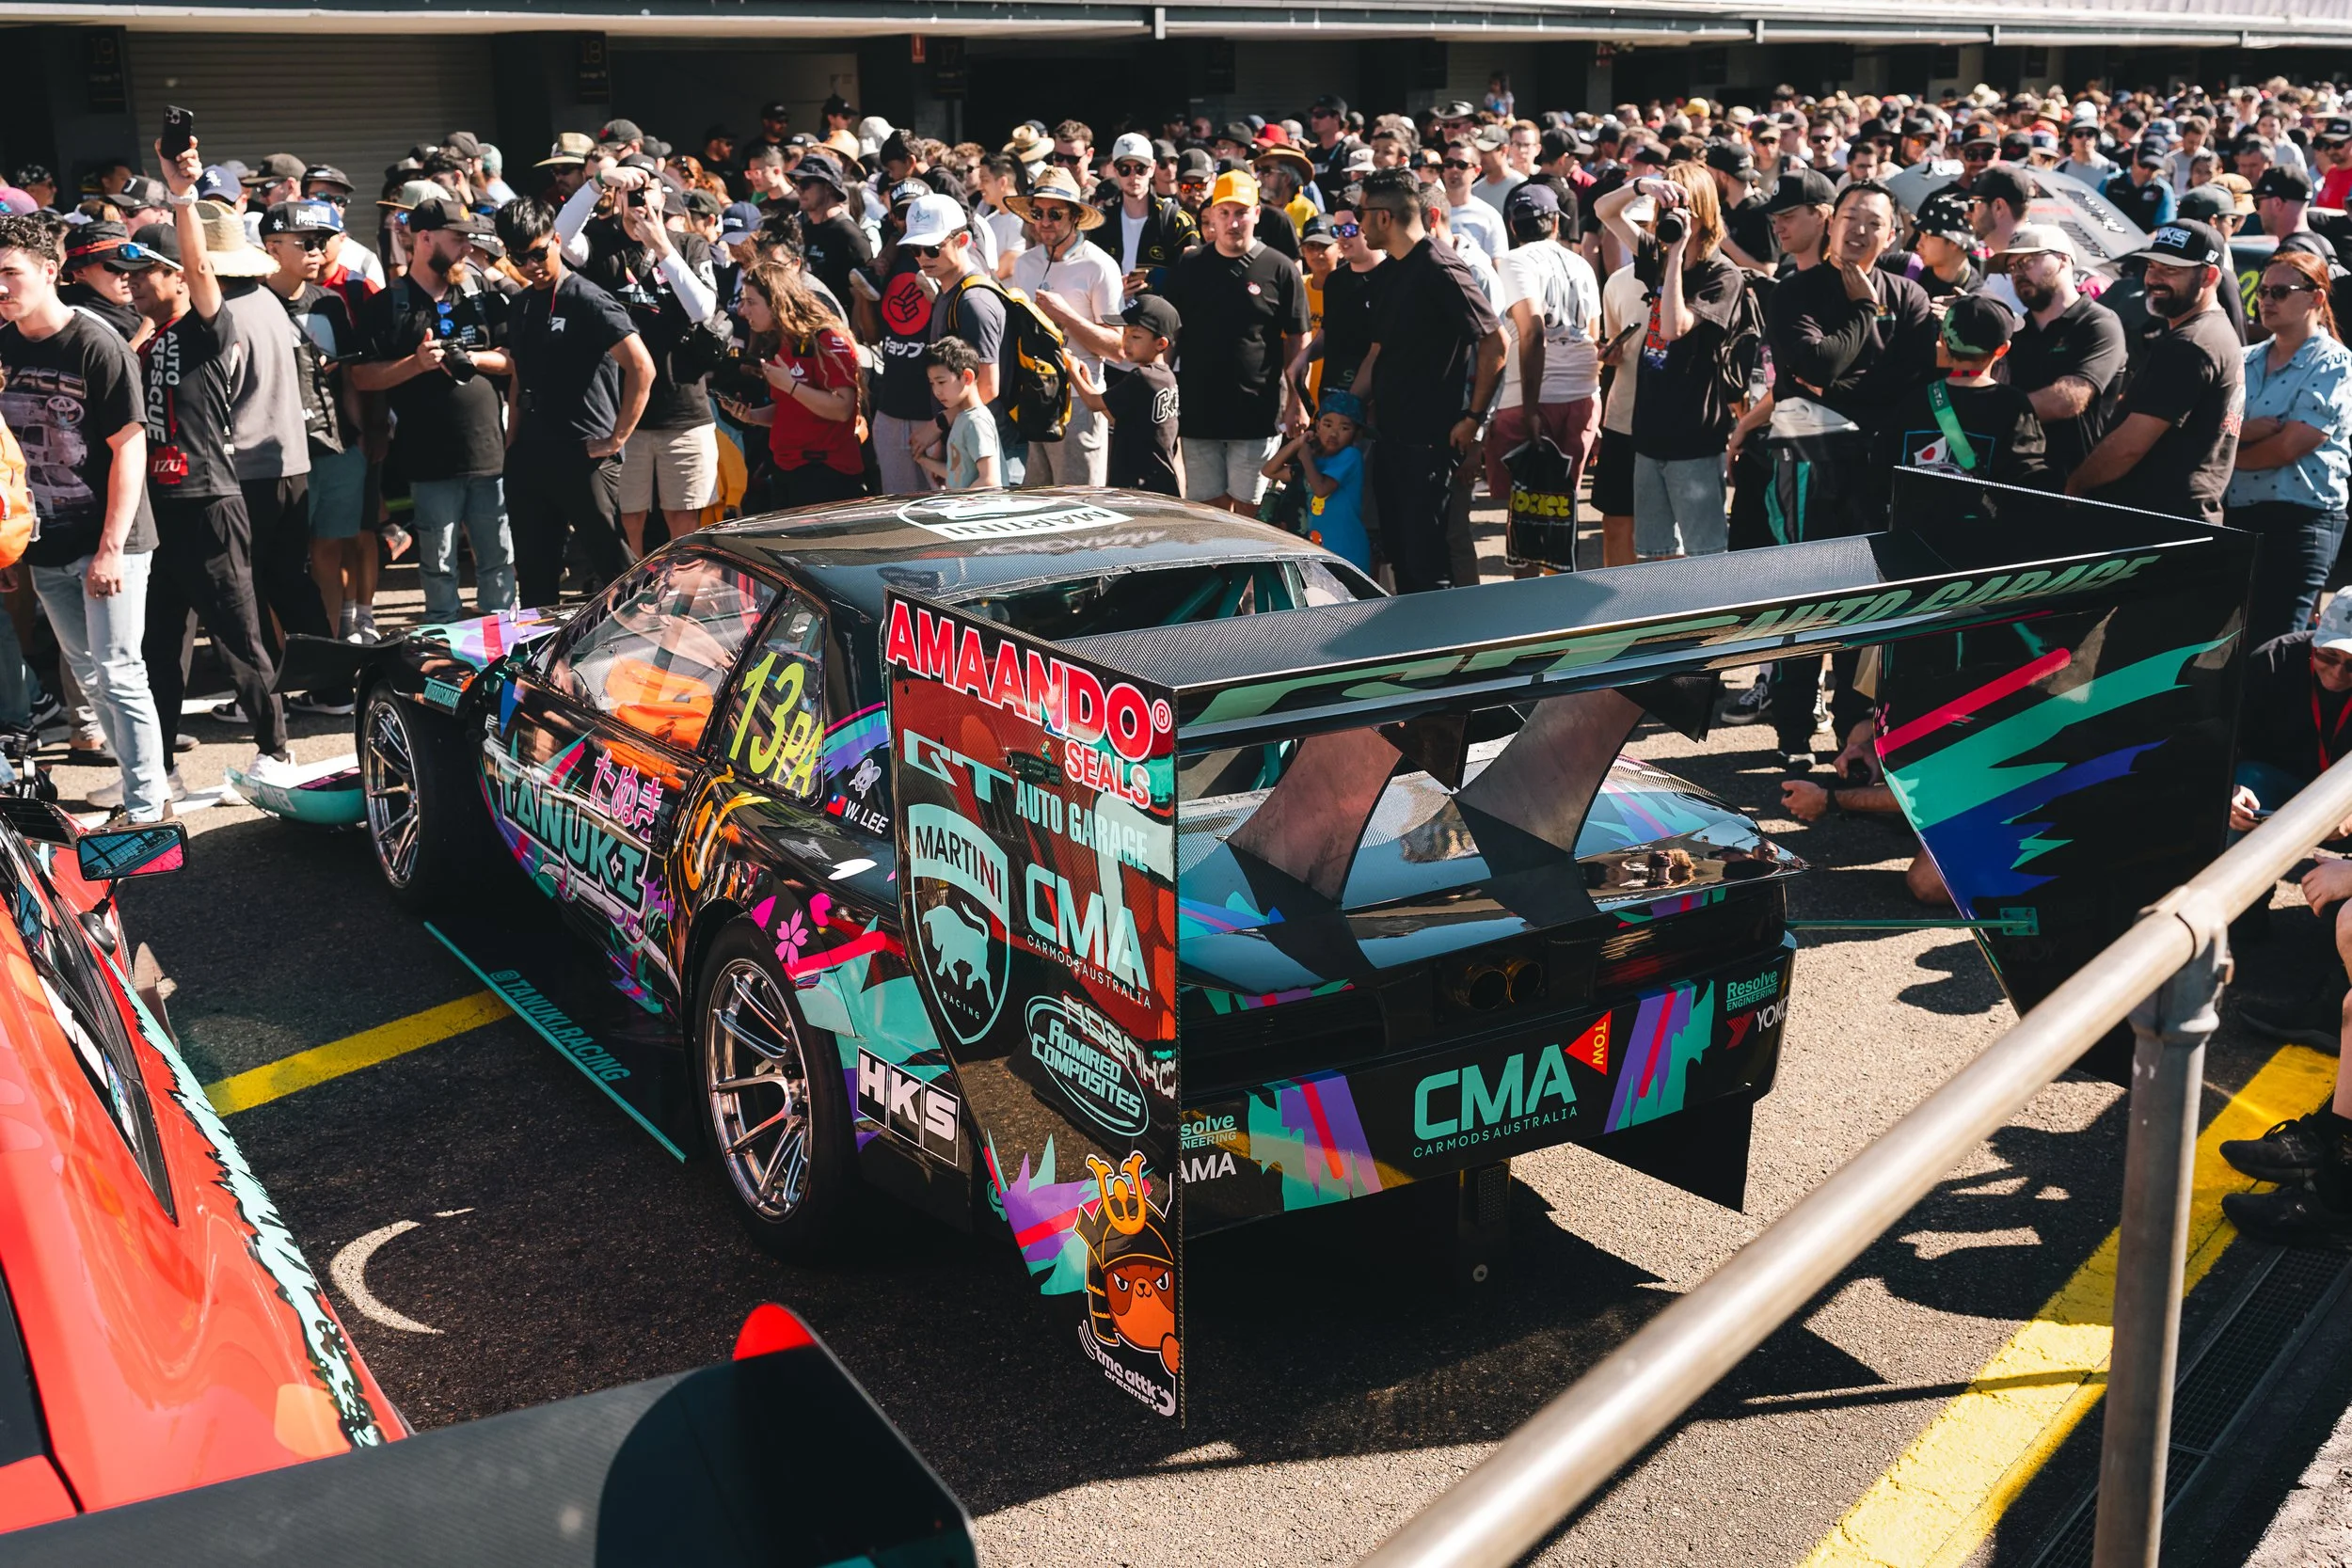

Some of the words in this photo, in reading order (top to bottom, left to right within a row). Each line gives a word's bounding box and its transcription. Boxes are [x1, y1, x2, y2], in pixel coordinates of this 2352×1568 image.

[10, 366, 87, 399] ACE
[165, 331, 181, 386] AUTO
[147, 337, 167, 444] RESCUE
[152, 459, 183, 473] IZU
[946, 511, 1113, 535] MARTINI
[1511, 490, 1571, 518] ocket
[1718, 589, 1913, 643] AUTO
[1911, 554, 2162, 615] GARAGE
[590, 748, 664, 843] たぬき
[903, 728, 1014, 803] GT
[1064, 738, 1152, 810] SEALS
[497, 762, 645, 907] TANUKI
[844, 800, 859, 822] W.
[860, 808, 889, 834] LEE
[1016, 781, 1063, 834] AUTO
[1069, 802, 1149, 873] GARAGE
[914, 825, 1002, 905] MARTINI
[1025, 863, 1151, 991] CMA
[943, 990, 980, 1021] RACING
[1726, 985, 1778, 1012] ENGINEERING
[1727, 971, 1778, 999] Resolve
[1048, 1018, 1122, 1084] ADMIRED
[1592, 1021, 1607, 1066] TOW
[859, 1053, 958, 1142] HKS
[1032, 1033, 1141, 1118] COMPOSITES
[1414, 1043, 1578, 1141] CMA
[1181, 1113, 1235, 1136] solve
[1181, 1131, 1237, 1150] NEERING
[1180, 1151, 1237, 1184] AMA
